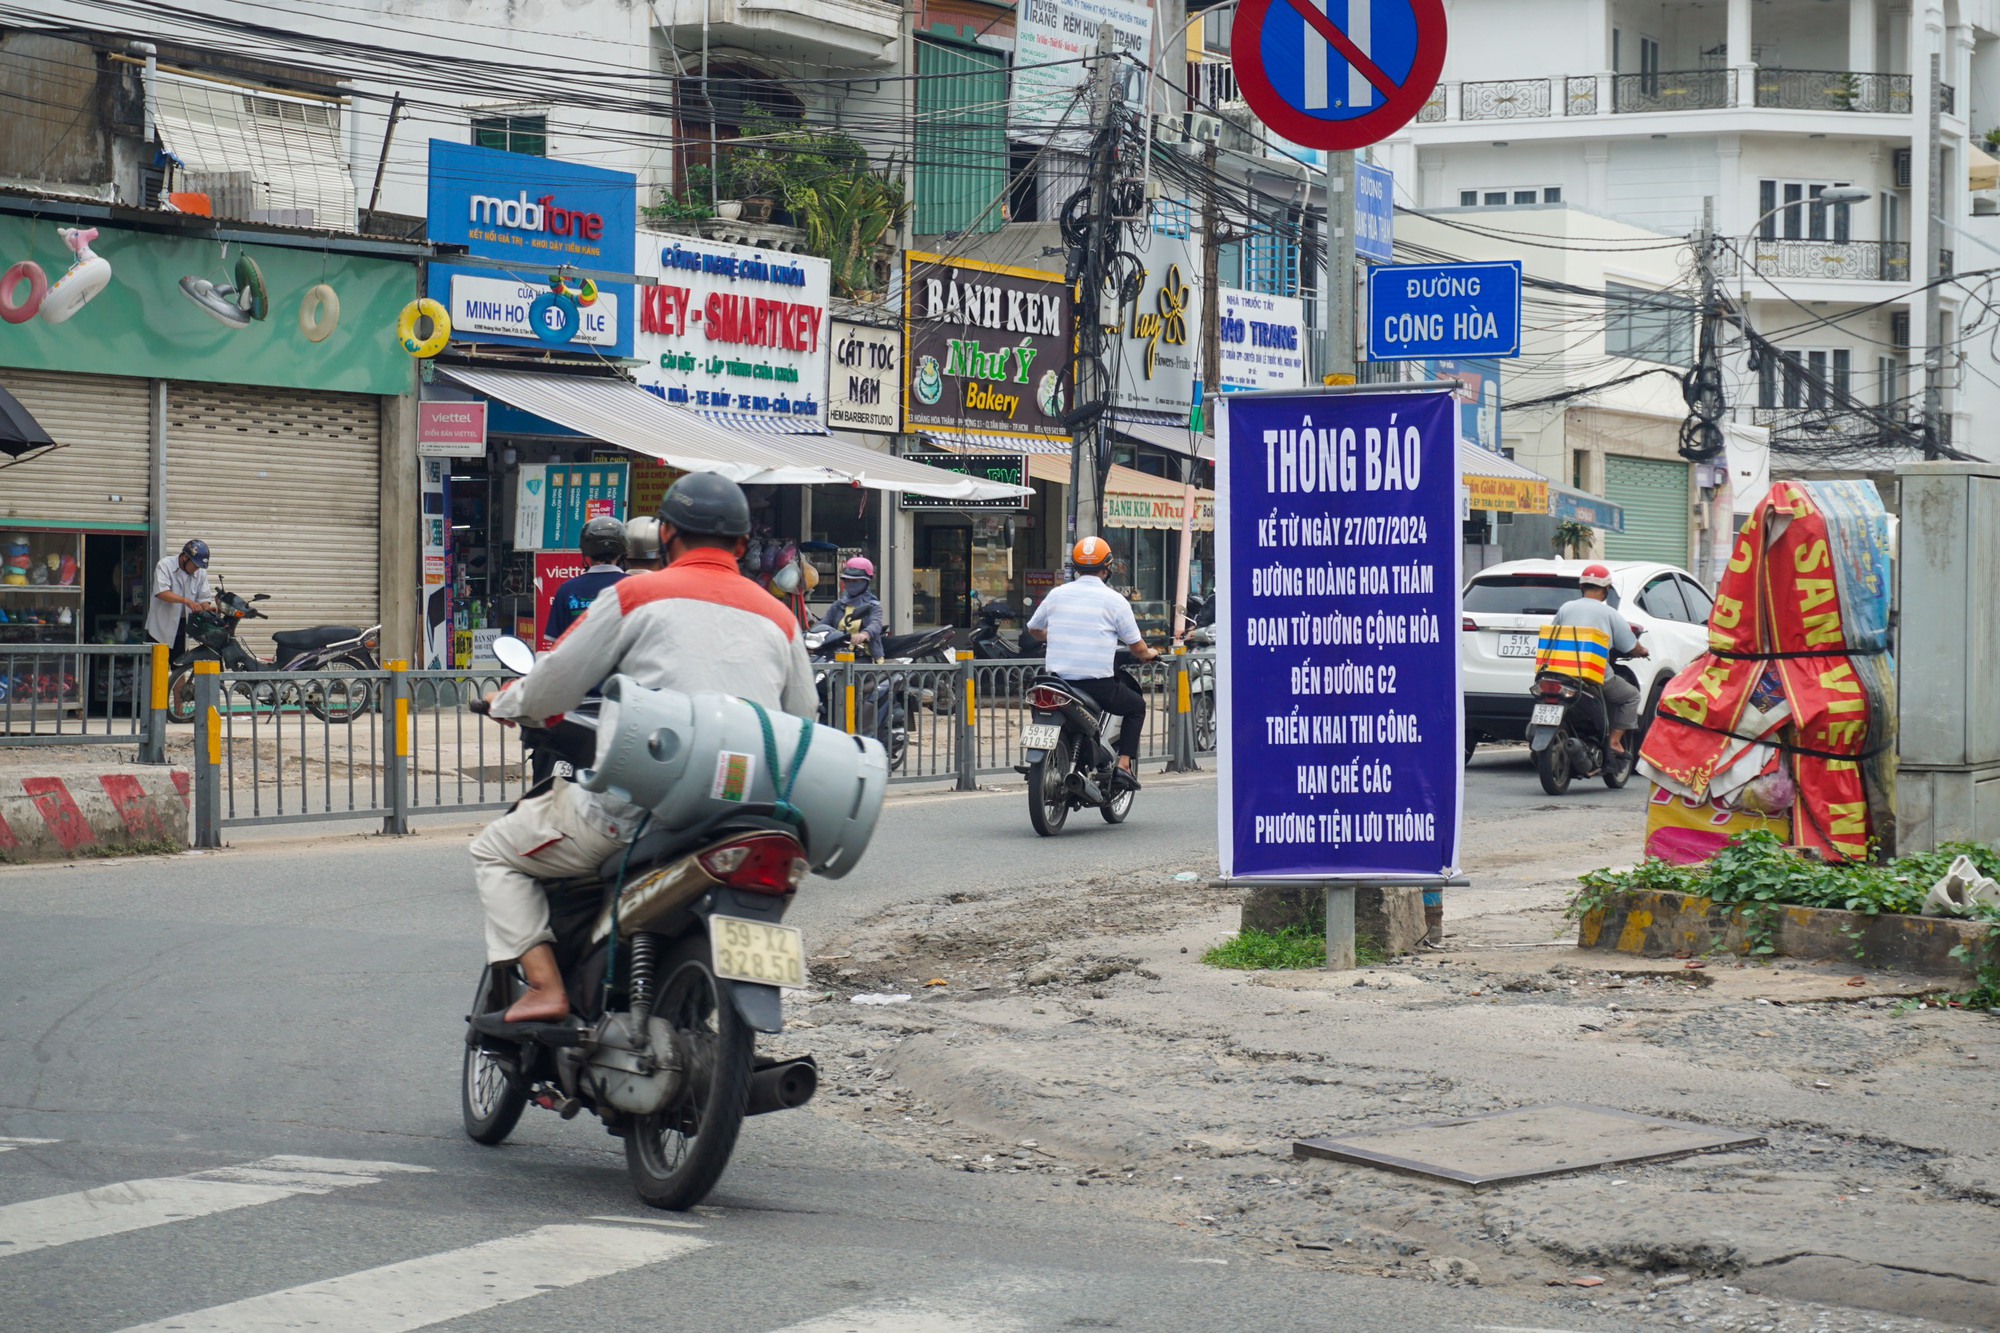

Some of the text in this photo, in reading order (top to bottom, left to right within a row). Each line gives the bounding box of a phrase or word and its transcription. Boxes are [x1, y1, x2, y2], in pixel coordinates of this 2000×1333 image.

[470, 190, 604, 240] mobifone
[927, 268, 1060, 336] BÁNH KEM
[1407, 272, 1481, 298] ĐƯỜNG
[466, 300, 500, 320] MINH
[641, 285, 690, 336] KEY
[704, 292, 822, 353] SMARTKEY
[1226, 295, 1274, 311] NHÀ THUỐC TÂY
[1250, 320, 1298, 351] TRANG
[1384, 304, 1498, 349] CỘNG HÒA
[870, 336, 894, 370] TÓC
[944, 338, 1010, 382] Như
[850, 376, 880, 404] NAM
[966, 382, 1019, 419] Bakery
[432, 413, 471, 422] viettel
[845, 411, 870, 424] BARBER
[870, 414, 893, 426] STUDIO
[1264, 413, 1420, 493] THÔNG BÁO
[1109, 496, 1132, 516] BÁNH
[1134, 502, 1150, 517] KEM
[1258, 507, 1427, 547] KỂ TỪ NGÀY 27/07/2024
[1252, 560, 1434, 596] ĐƯỜNG HOÀNG HOA THÁM
[1248, 608, 1440, 652] ĐOẠN TỪ ĐƯỜNG CỘNG HÒA
[1512, 636, 1530, 645] 51K
[1503, 646, 1536, 656] 077.34
[1291, 658, 1396, 695] ĐẾN ĐƯỜNG C2
[1028, 726, 1054, 737] 59-V2
[1266, 704, 1422, 744] TRIỂN KHAI THI CÔNG.
[1298, 756, 1392, 800] HẠN CHẾ CÁC
[1256, 808, 1435, 849] PHƯƠNG TIỆN LƯU THÔNG
[726, 922, 789, 954] 59-X2
[719, 948, 800, 982] 328.50
